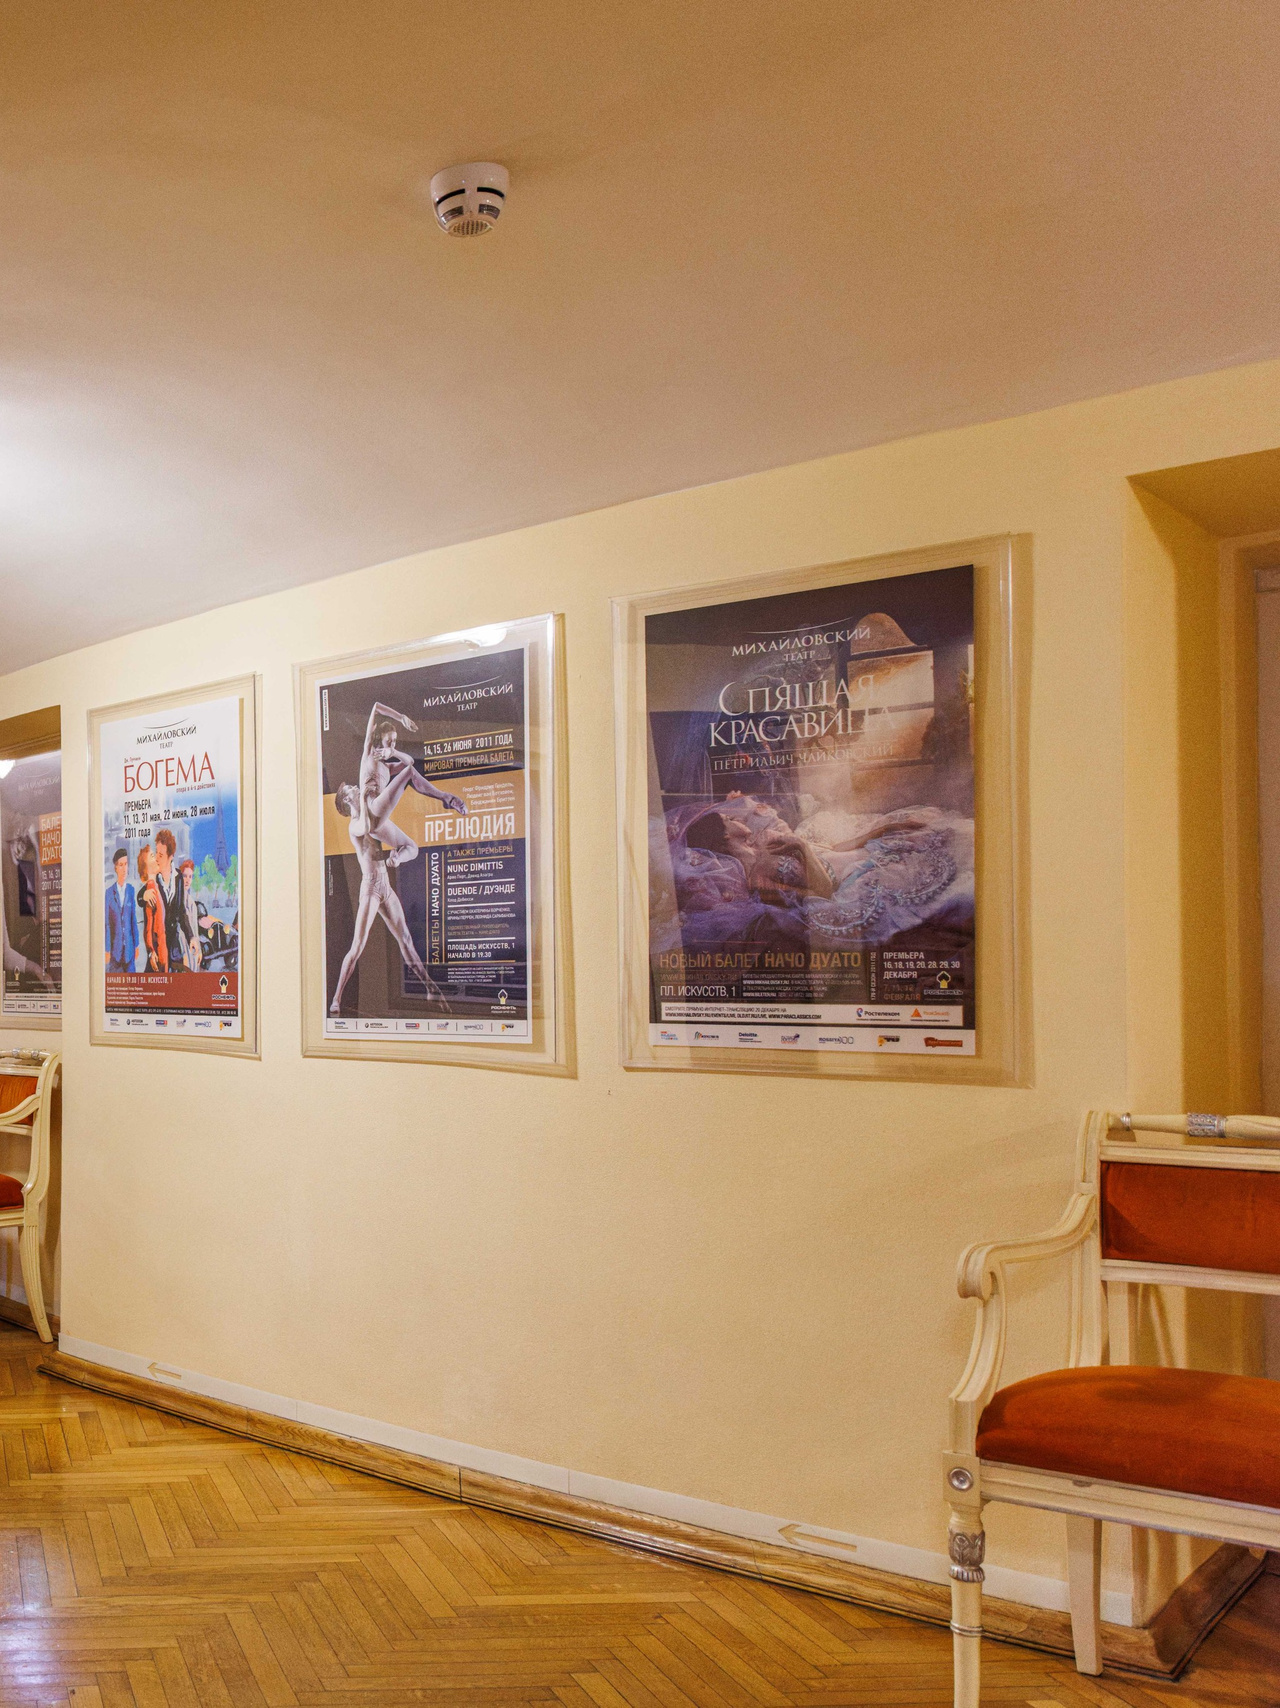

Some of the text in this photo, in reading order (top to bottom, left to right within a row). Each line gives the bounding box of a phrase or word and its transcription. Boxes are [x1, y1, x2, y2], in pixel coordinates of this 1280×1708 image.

[732, 625, 871, 657] МИХАЙЛОВСКИЙ
[784, 650, 816, 662] ТЕАТР
[423, 682, 513, 707] МИХАЙЛОВСКИЙ
[457, 702, 478, 711] ТЕАТР
[709, 706, 896, 747] КРАСАВИЦА
[136, 724, 197, 745] МИХАЙЛОВСКИЙ
[160, 741, 173, 749] ТЕАТР
[443, 743, 452, 753] 26
[452, 739, 472, 752] ИЮНЯ
[475, 736, 492, 748] 2011
[495, 734, 513, 746] ГОДА
[424, 751, 514, 772] МИРОВАЯ ПРЕМЬЕРА БАЛЕТА
[750, 753, 794, 767] ИЛЬИЧ
[124, 751, 215, 793] БОГЕМА
[124, 799, 151, 812] ПРЕМЬЕРА
[142, 812, 148, 822] 31
[164, 809, 170, 820] 22
[190, 805, 198, 816] 28
[199, 805, 215, 815] июля
[41, 816, 61, 830] БАЛЕ
[424, 812, 515, 842] ПРЕЛЮДИЯ
[41, 831, 61, 847] НАЧО
[125, 828, 151, 838] 2011 года
[453, 848, 475, 857] ТАКЖЕ
[477, 845, 513, 855] ПРЕМЬЕРЫ
[447, 861, 504, 873] NUNC DIMITTIS
[447, 886, 477, 896] DUENDE
[484, 884, 515, 895] ДУЭНДЕ
[431, 852, 440, 964] БАЛЕТЫ НАЧО ДУАТО
[447, 943, 477, 951] ПЛОЩАДЬ
[478, 942, 510, 950] ИСКУССТВ,
[660, 950, 861, 970] НОВЫЙ БАЛЕТ НАЧО ДУАТО
[883, 952, 924, 960] ПРЕМЬЕРА
[883, 971, 918, 979] ДЕКАБРЯ
[660, 985, 736, 998] ПЛ. ИСКУССТВ, 1
